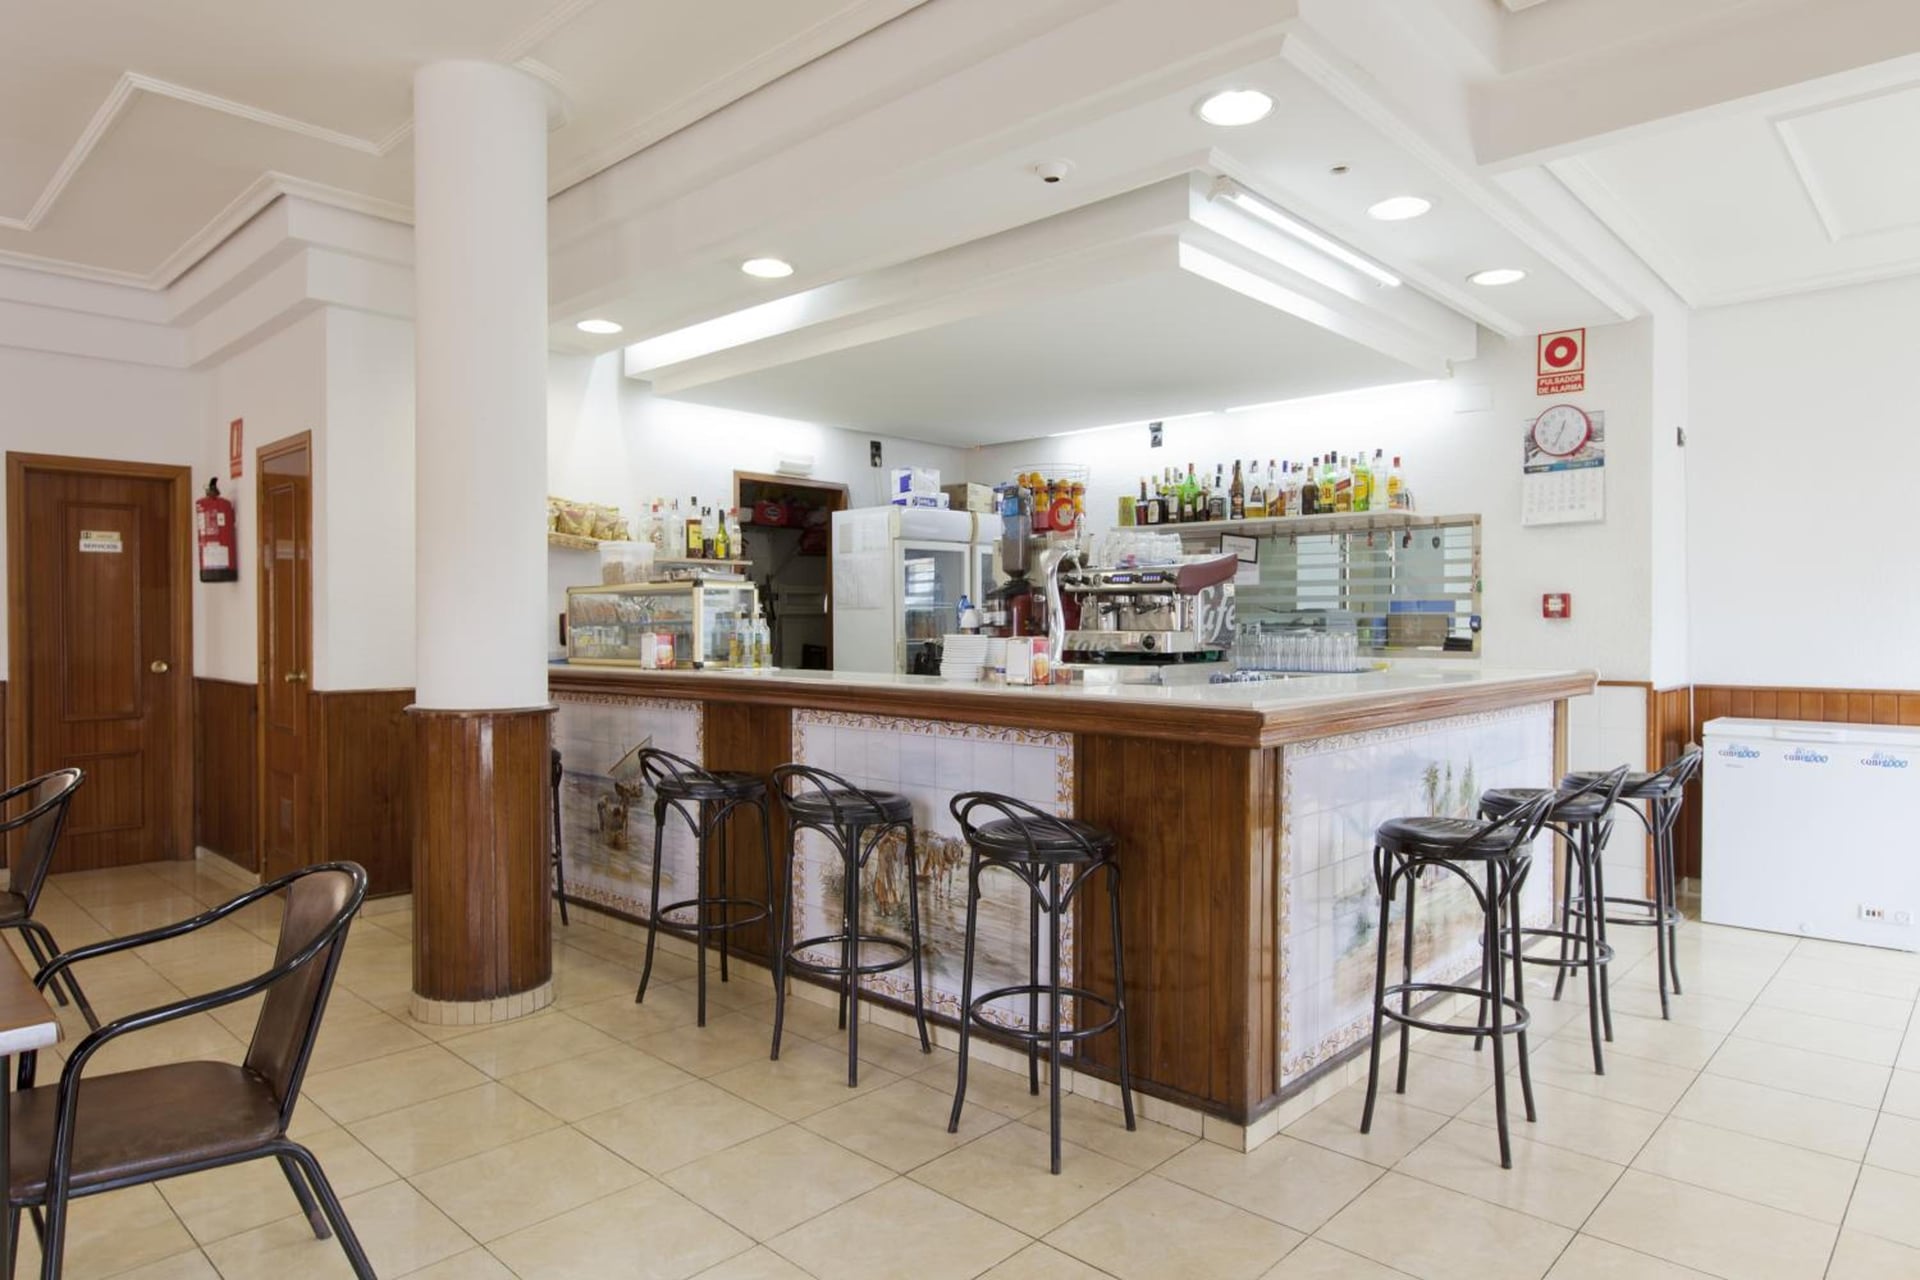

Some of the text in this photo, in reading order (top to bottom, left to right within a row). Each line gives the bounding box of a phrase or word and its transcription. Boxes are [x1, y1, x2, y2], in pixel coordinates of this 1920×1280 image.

[1539, 375, 1582, 386] PULSADOR
[1538, 382, 1583, 395] DE ALARMA
